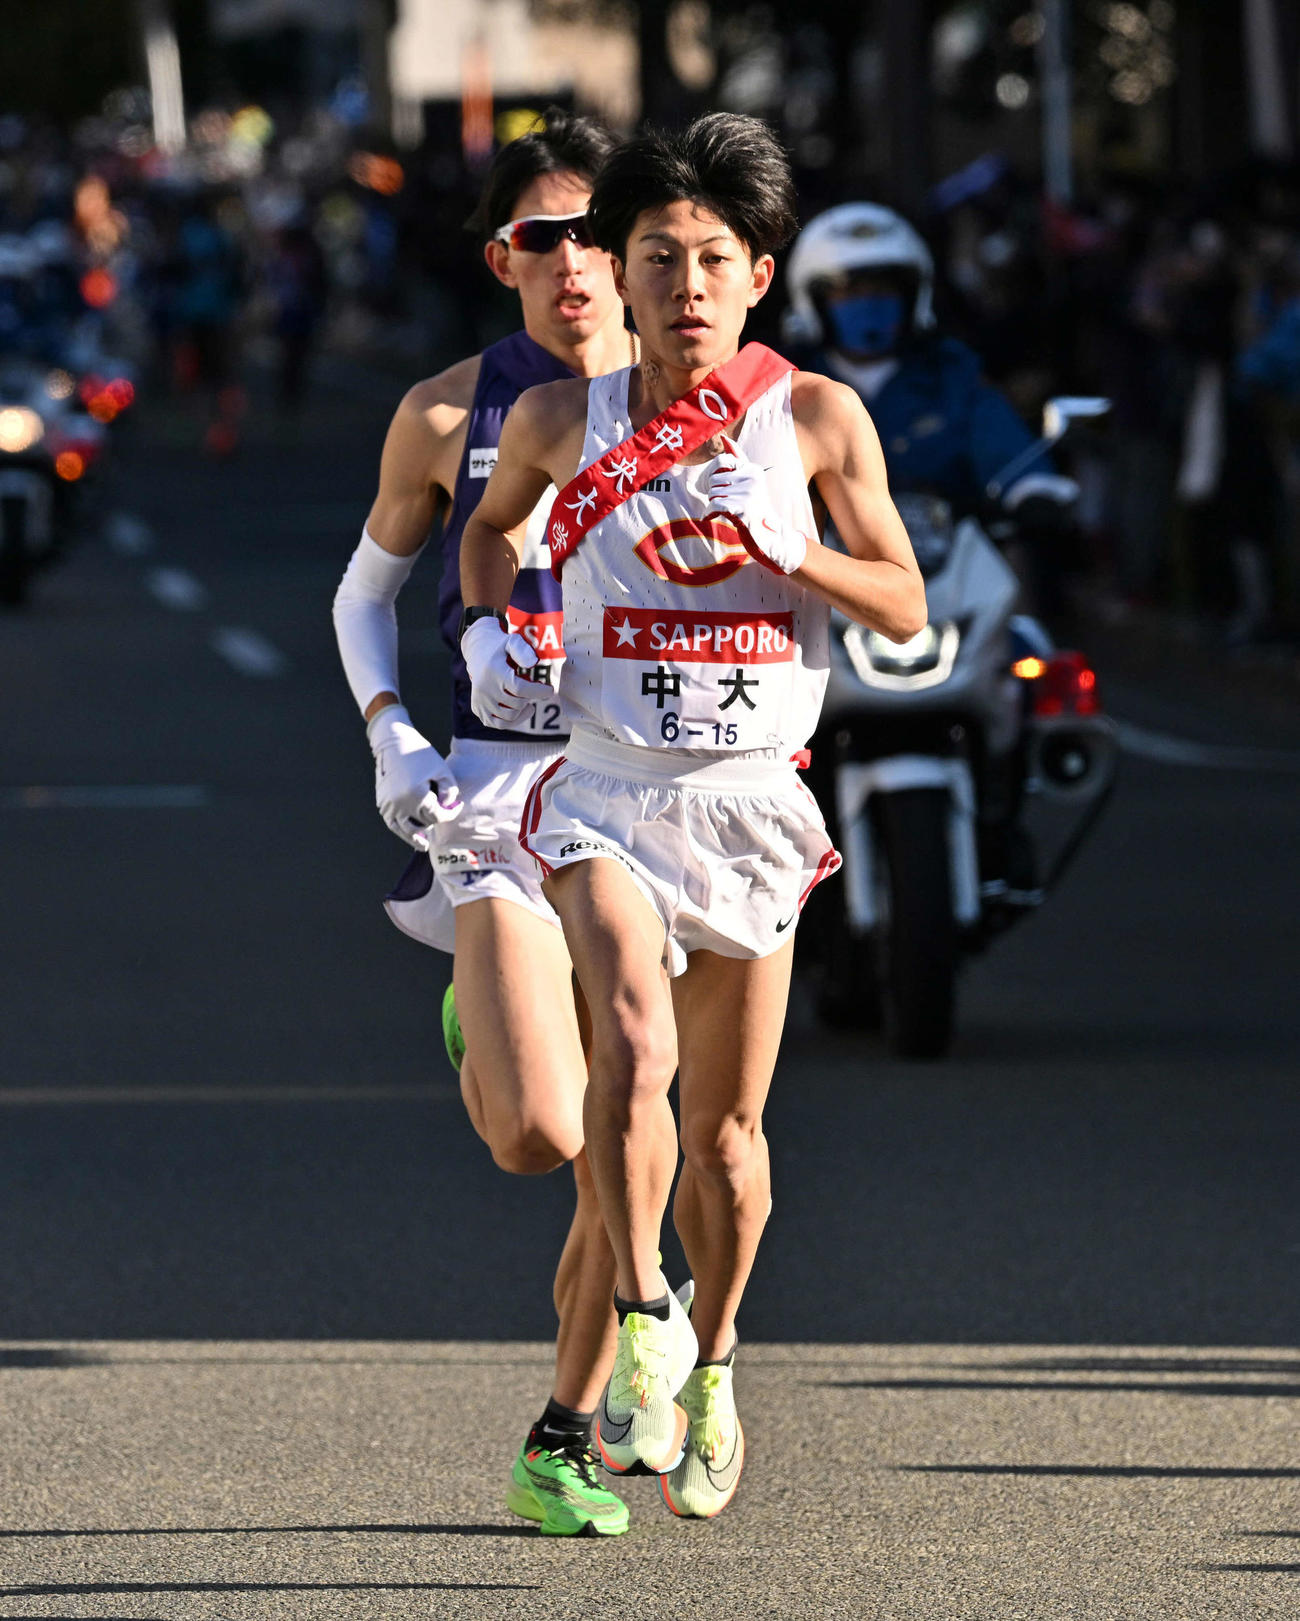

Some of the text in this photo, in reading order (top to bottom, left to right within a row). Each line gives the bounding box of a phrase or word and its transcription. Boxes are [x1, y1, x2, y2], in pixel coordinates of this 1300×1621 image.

[523, 624, 563, 651] SA
[650, 622, 789, 654] SAPPORO
[660, 711, 738, 745] 6-15
